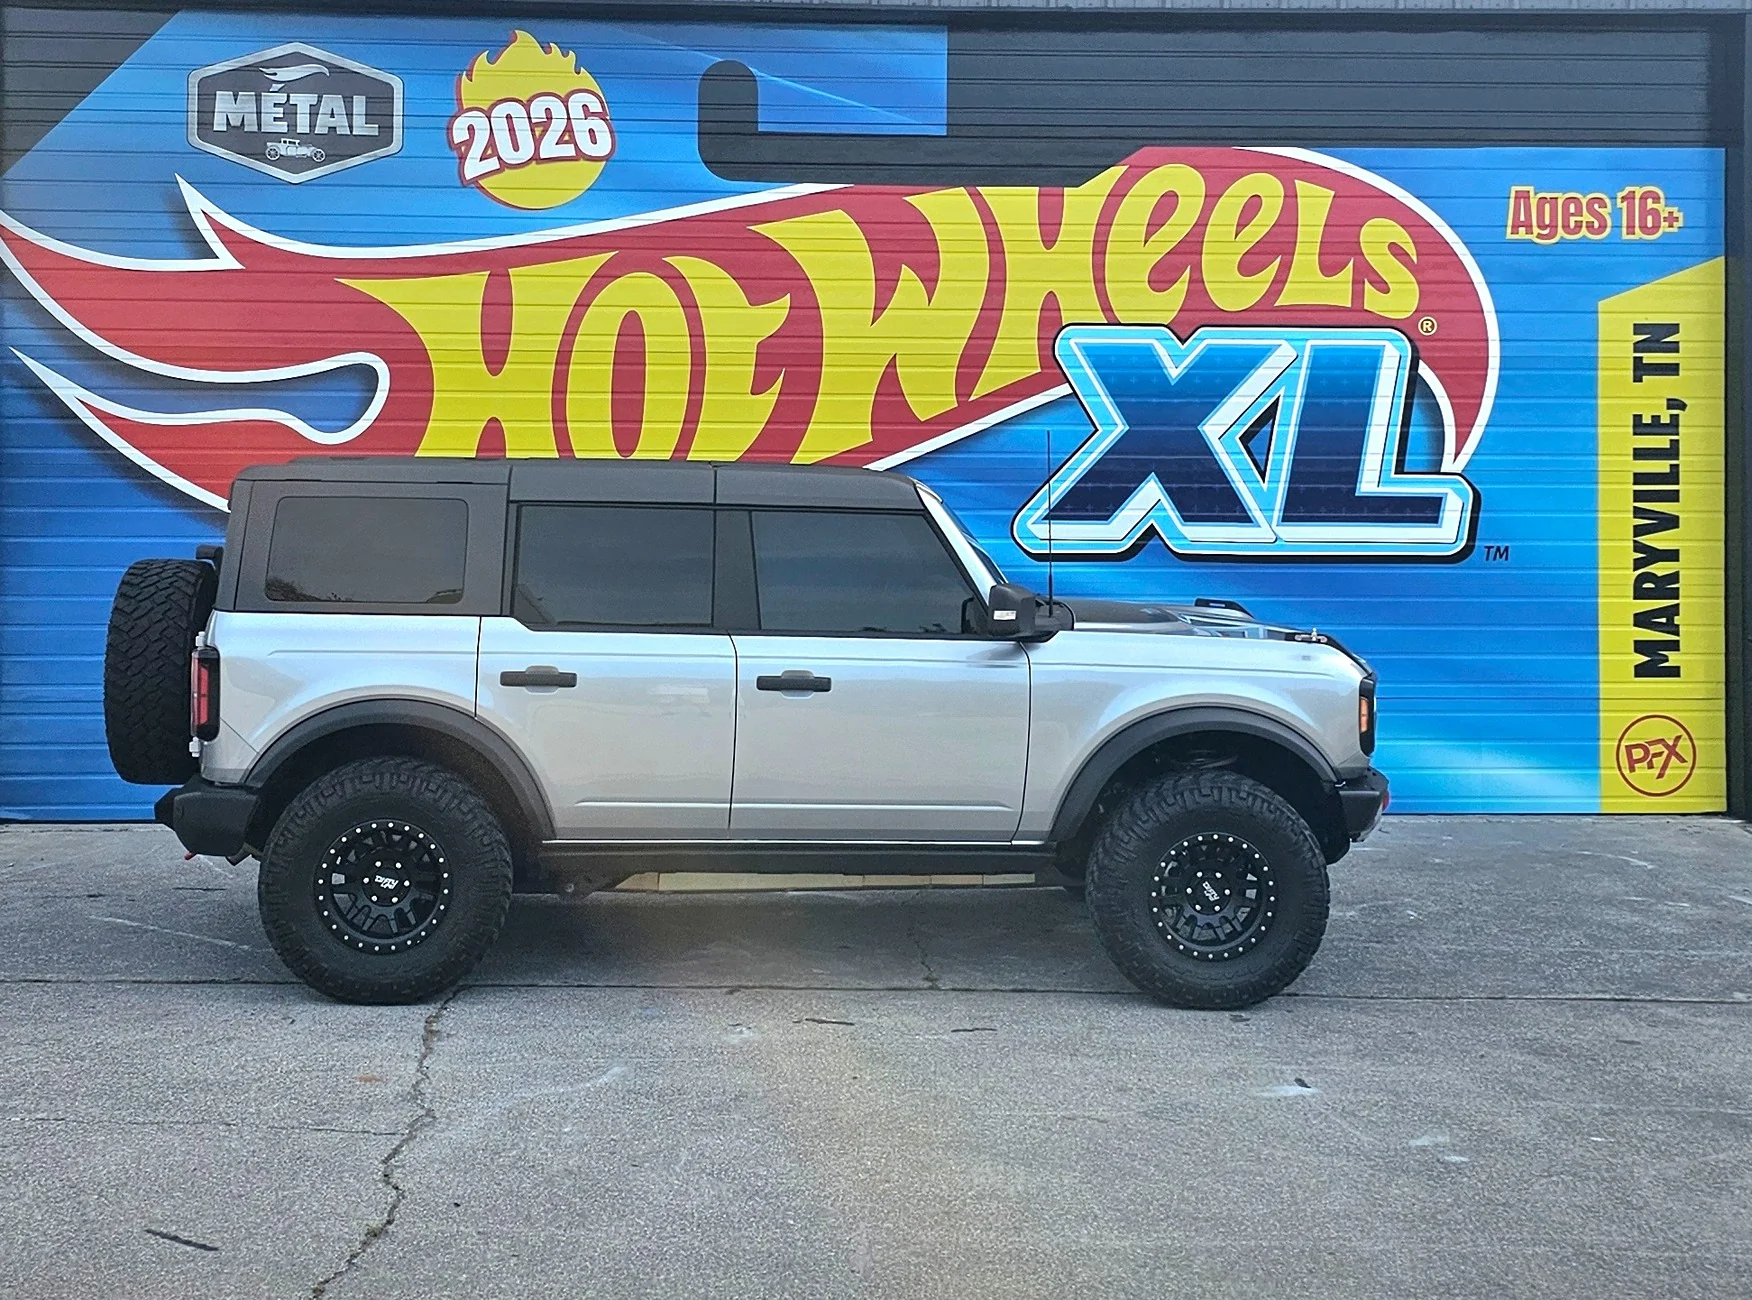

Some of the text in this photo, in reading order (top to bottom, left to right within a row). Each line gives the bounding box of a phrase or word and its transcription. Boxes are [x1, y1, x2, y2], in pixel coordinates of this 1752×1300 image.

[452, 91, 613, 182] 2026
[1508, 187, 1683, 242] Ages 16+
[334, 250, 791, 460] HOT
[1016, 327, 1474, 555] XL
[1632, 322, 1688, 679] MARYVILLE, TN
[1624, 734, 1689, 780] PFX
